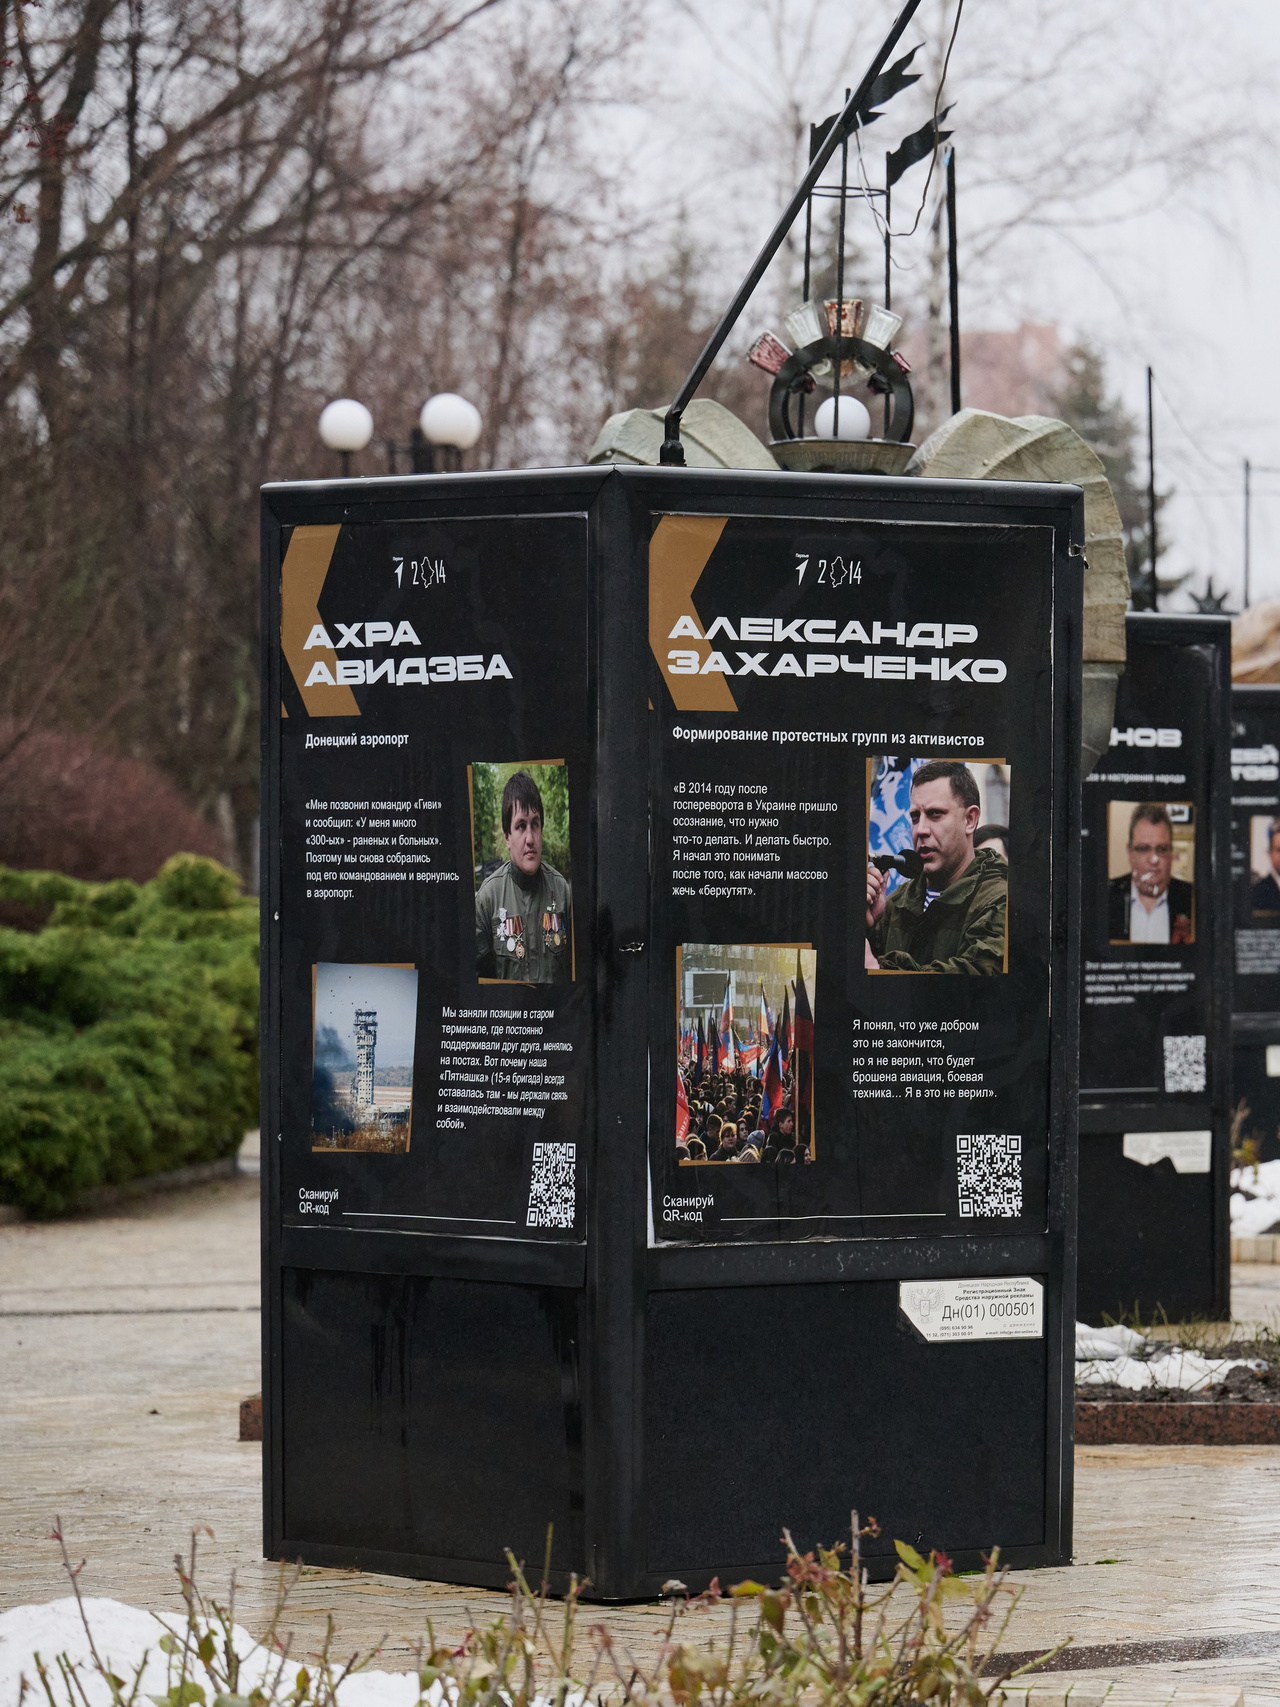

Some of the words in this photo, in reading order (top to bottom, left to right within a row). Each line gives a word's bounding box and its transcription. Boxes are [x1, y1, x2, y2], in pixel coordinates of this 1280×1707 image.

[303, 620, 422, 650] АХРА
[667, 615, 979, 649] АЛЕКСАНДР
[303, 654, 514, 687] АВИДЗБА
[667, 649, 1008, 684] ЗАХАРЧЕНКО
[305, 732, 357, 749] Донецкий
[360, 734, 409, 748] аэропорт
[672, 726, 769, 743] Формирование
[772, 731, 848, 745] протестных
[852, 732, 887, 746] групп
[892, 734, 906, 744] из
[909, 734, 985, 746] активистов
[674, 782, 686, 793] «В
[689, 782, 712, 794] 2014
[715, 785, 736, 797] году
[738, 785, 768, 794] после
[305, 799, 328, 810] «Мне
[330, 801, 369, 810] позвонил
[371, 801, 412, 812] командир
[414, 798, 442, 810] «Гиви»
[673, 801, 744, 813] госпереворота
[747, 802, 753, 810] в
[755, 800, 796, 813] Украине
[799, 802, 838, 814] пришло
[305, 819, 311, 827] и
[313, 816, 353, 829] сообщил:
[356, 817, 367, 828] «У
[369, 819, 390, 828] меня
[392, 819, 417, 828] много
[673, 817, 726, 828] осознание,
[729, 818, 746, 827] что
[748, 818, 779, 829] нужно
[306, 834, 345, 846] «300-ых»
[353, 837, 389, 848] раненых
[391, 837, 397, 845] и
[399, 834, 442, 846] больных».
[673, 836, 703, 845] что-то
[705, 836, 742, 846] делать.
[745, 834, 753, 845] И
[755, 836, 790, 847] делать
[793, 834, 832, 848] быстро.
[306, 852, 342, 865] Поэтому
[344, 854, 357, 863] мы
[359, 854, 384, 863] снова
[386, 852, 431, 865] собрались
[673, 849, 680, 861] Я
[683, 852, 711, 861] начал
[714, 852, 730, 861] это
[733, 852, 781, 862] понимать
[306, 872, 322, 882] под
[323, 872, 337, 880] его
[339, 872, 406, 882] командованием
[409, 872, 414, 880] и
[416, 872, 460, 883] вернулись
[673, 870, 701, 879] после
[730, 870, 746, 880] как
[748, 871, 783, 880] начали
[787, 871, 828, 880] массово
[307, 889, 312, 898] в
[314, 889, 354, 900] аэропорт.
[672, 886, 696, 896] жечь
[698, 884, 756, 899] «беркутят».
[442, 1006, 457, 1018] Мы
[459, 1009, 488, 1018] заняли
[490, 1010, 522, 1020] позиции
[523, 1010, 528, 1019] в
[529, 1010, 554, 1021] старом
[442, 1025, 489, 1036] терминале,
[491, 1026, 504, 1036] где
[505, 1026, 543, 1035] постоянно
[853, 1019, 861, 1030] Я
[863, 1021, 896, 1031] понял,
[899, 1021, 916, 1030] что
[918, 1022, 938, 1033] уже
[940, 1019, 979, 1033] добром
[441, 1041, 500, 1052] поддерживали
[543, 1042, 573, 1052] менялись
[852, 1039, 869, 1048] это
[872, 1039, 884, 1048] не
[886, 1039, 945, 1049] закончится,
[440, 1056, 451, 1065] на
[452, 1057, 482, 1066] постах.
[484, 1055, 499, 1067] Вот
[500, 1058, 528, 1070] почему
[528, 1058, 547, 1067] наша
[853, 1057, 865, 1066] но
[867, 1057, 874, 1066] я
[876, 1057, 889, 1066] не
[891, 1057, 924, 1068] верил,
[927, 1057, 944, 1066] что
[946, 1055, 975, 1068] будет
[439, 1070, 489, 1082] «Пятнашка»
[491, 1072, 511, 1085] (15-я
[512, 1072, 543, 1086] бригада)
[544, 1075, 565, 1086] всегда
[852, 1071, 897, 1085] брошена
[900, 1073, 944, 1083] авиация,
[947, 1071, 983, 1082] боевая
[438, 1088, 484, 1099] оставалась
[486, 1090, 501, 1099] там
[507, 1091, 519, 1100] мы
[519, 1091, 550, 1102] держали
[905, 1086, 913, 1098] Я
[916, 1089, 922, 1098] в
[924, 1089, 941, 1098] это
[943, 1089, 956, 1098] не
[958, 1089, 997, 1100] верил».
[437, 1104, 443, 1112] и
[445, 1104, 522, 1116] взаимодействовали
[523, 1107, 546, 1119] между
[436, 1117, 466, 1129] собой».
[299, 1187, 339, 1202] Сканируй
[663, 1194, 714, 1209] Сканируй
[299, 1202, 330, 1215] QR-код
[663, 1210, 703, 1223] QR-код
[942, 1304, 985, 1322] Дн(01)
[990, 1302, 1034, 1317] 000501
